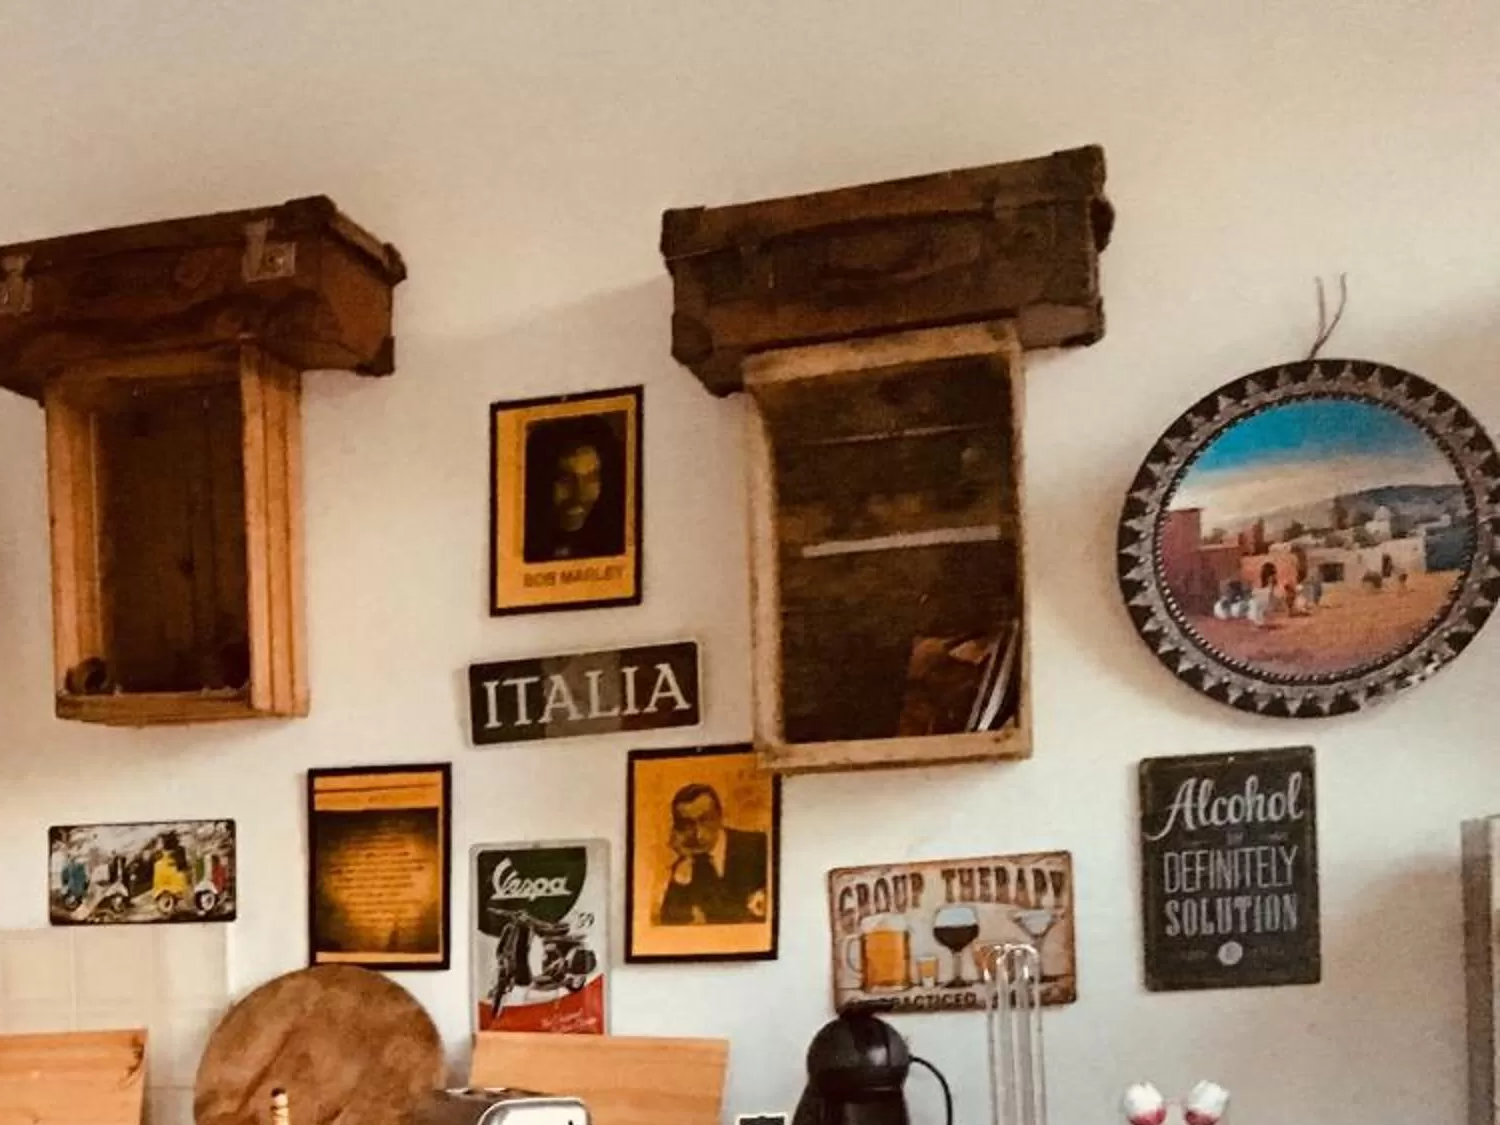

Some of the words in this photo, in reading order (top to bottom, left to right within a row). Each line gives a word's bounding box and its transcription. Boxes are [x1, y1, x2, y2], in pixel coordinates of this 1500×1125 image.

[523, 572, 556, 588] BOB
[560, 564, 625, 584] MARLEY
[482, 662, 692, 729] ITALIA
[1145, 771, 1304, 841] Alcohol
[490, 858, 573, 901] Vespa
[1164, 845, 1299, 893] DEFINITELY
[838, 872, 924, 931] GROUP
[941, 865, 1065, 910] THERAPY
[1165, 893, 1298, 937] SOLUTION
